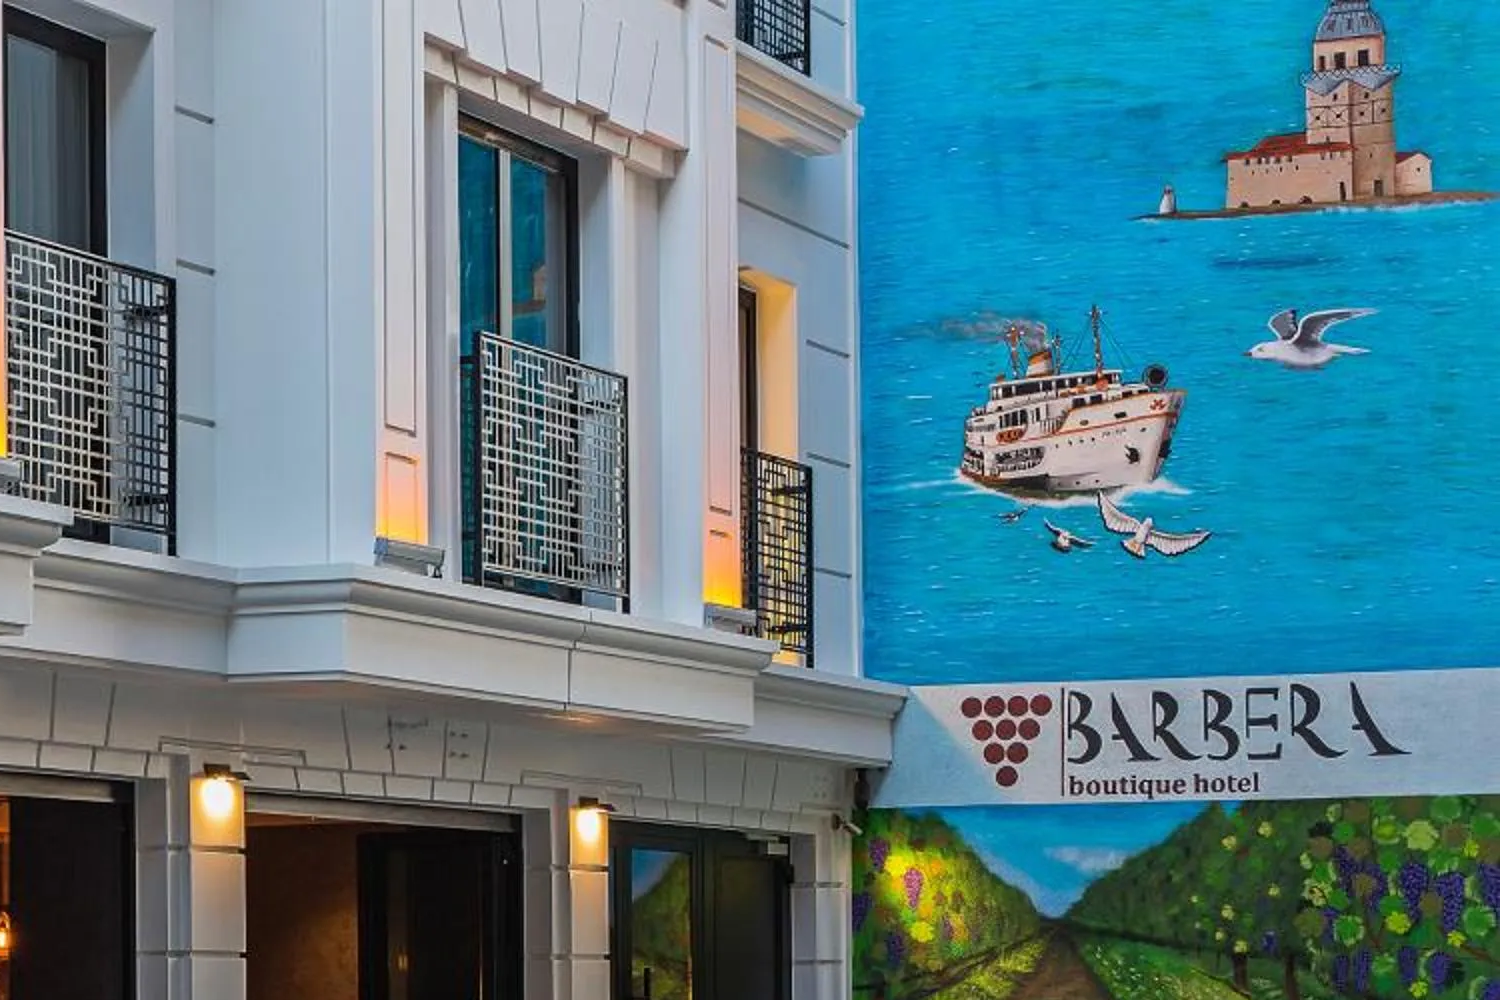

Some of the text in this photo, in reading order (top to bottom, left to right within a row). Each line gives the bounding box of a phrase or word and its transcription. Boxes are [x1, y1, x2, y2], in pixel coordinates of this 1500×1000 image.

[1067, 682, 1411, 764] BARBERA
[1069, 773, 1260, 799] boutique hotel
